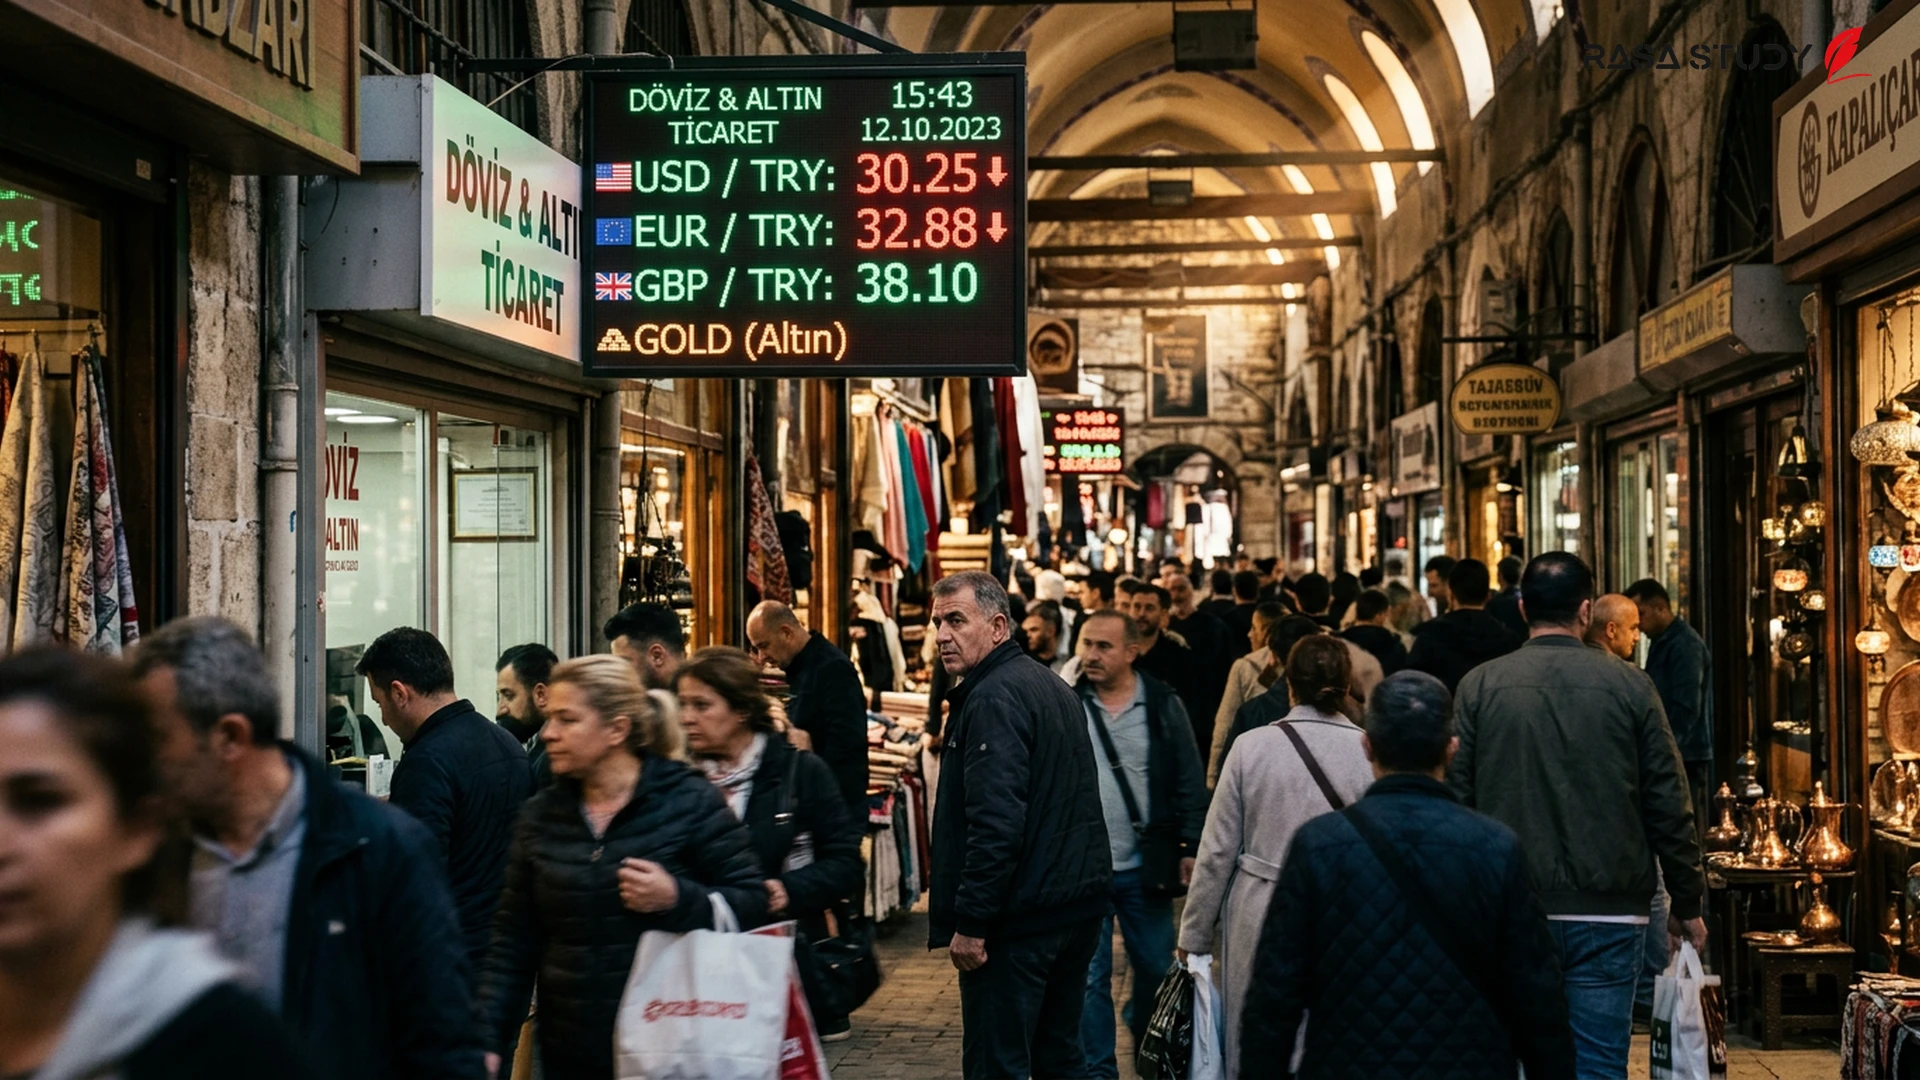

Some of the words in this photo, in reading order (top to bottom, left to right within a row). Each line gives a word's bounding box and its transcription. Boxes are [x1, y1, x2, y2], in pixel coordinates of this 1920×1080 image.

[629, 82, 711, 112] DÖVİZ
[718, 87, 739, 111] &
[745, 86, 822, 111] ALTIN
[892, 80, 973, 109] 15:43
[667, 115, 780, 145] TİCARET
[861, 116, 1001, 142] 12.10.2023
[446, 133, 512, 231] DÖVİZ
[519, 178, 533, 240] &
[635, 159, 711, 193] USD
[721, 158, 739, 199] /
[749, 158, 835, 192] TRY:
[856, 152, 978, 195] 30.25
[635, 214, 710, 248] EUR
[720, 212, 737, 254] /
[748, 213, 833, 247] TRY:
[856, 206, 978, 250] 32.88
[481, 240, 565, 336] TİCARET
[634, 268, 709, 302] GBP
[719, 267, 736, 308] /
[747, 268, 832, 301] TRY:
[856, 261, 978, 304] 38.10
[634, 323, 733, 355] GOLD
[744, 320, 847, 362] (Altın)
